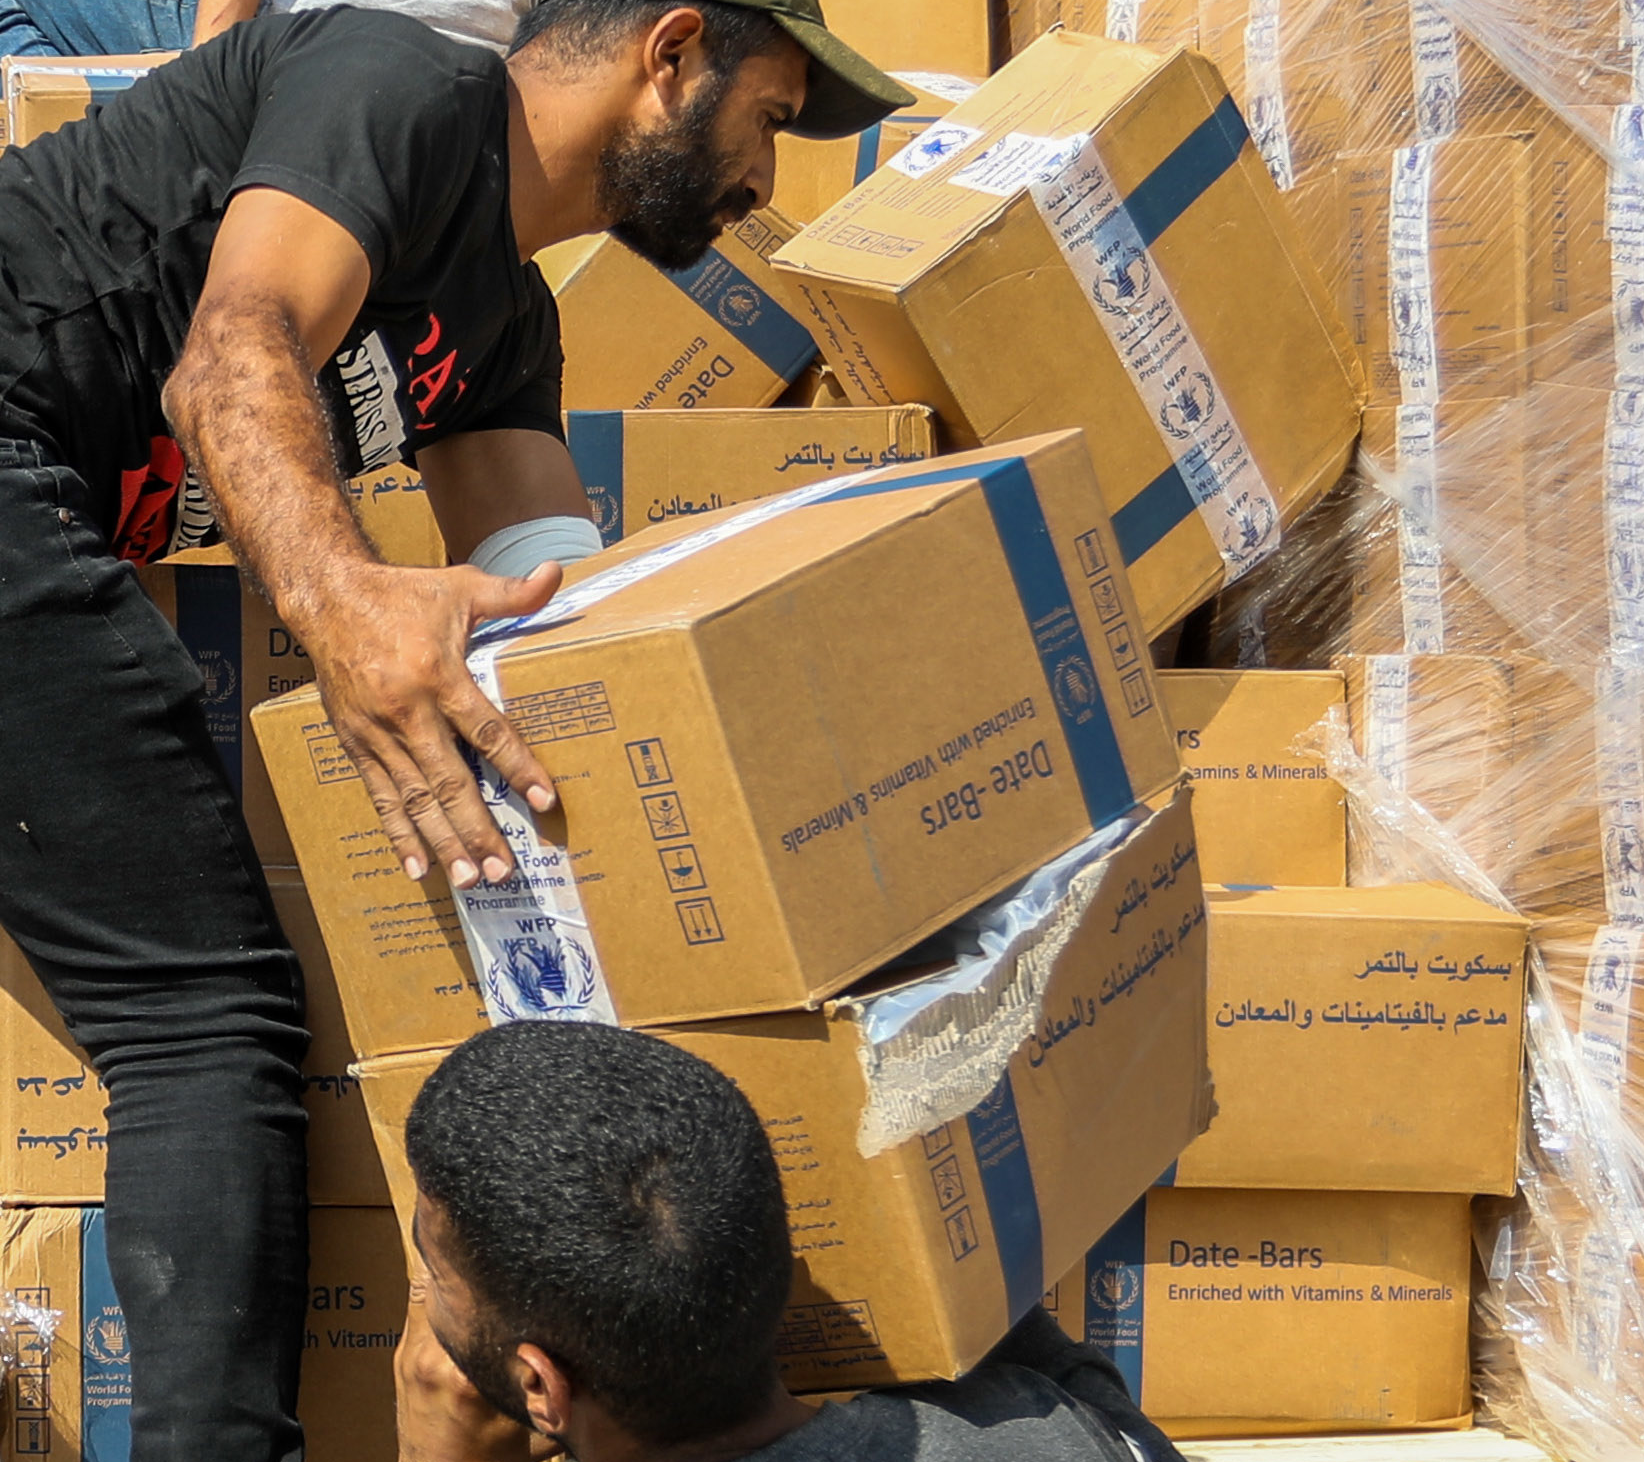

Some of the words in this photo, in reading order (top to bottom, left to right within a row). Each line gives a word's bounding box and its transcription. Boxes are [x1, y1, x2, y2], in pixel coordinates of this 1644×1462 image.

[989, 739, 1054, 795] Date
[1354, 950, 1419, 980] بالتمر
[1427, 954, 1512, 982] بسكويت
[1215, 998, 1313, 1030] والمعادن
[1321, 1001, 1446, 1032] بالفيتامينات
[1453, 1008, 1508, 1034] مدعم
[1169, 1239, 1240, 1269] Date
[1247, 1240, 1323, 1269] -Bars
[1168, 1283, 1243, 1301] Enriched
[1246, 1284, 1285, 1301] with
[1290, 1284, 1364, 1302] Vitamins
[1370, 1284, 1384, 1302] &
[1387, 1284, 1453, 1302] Minerals
